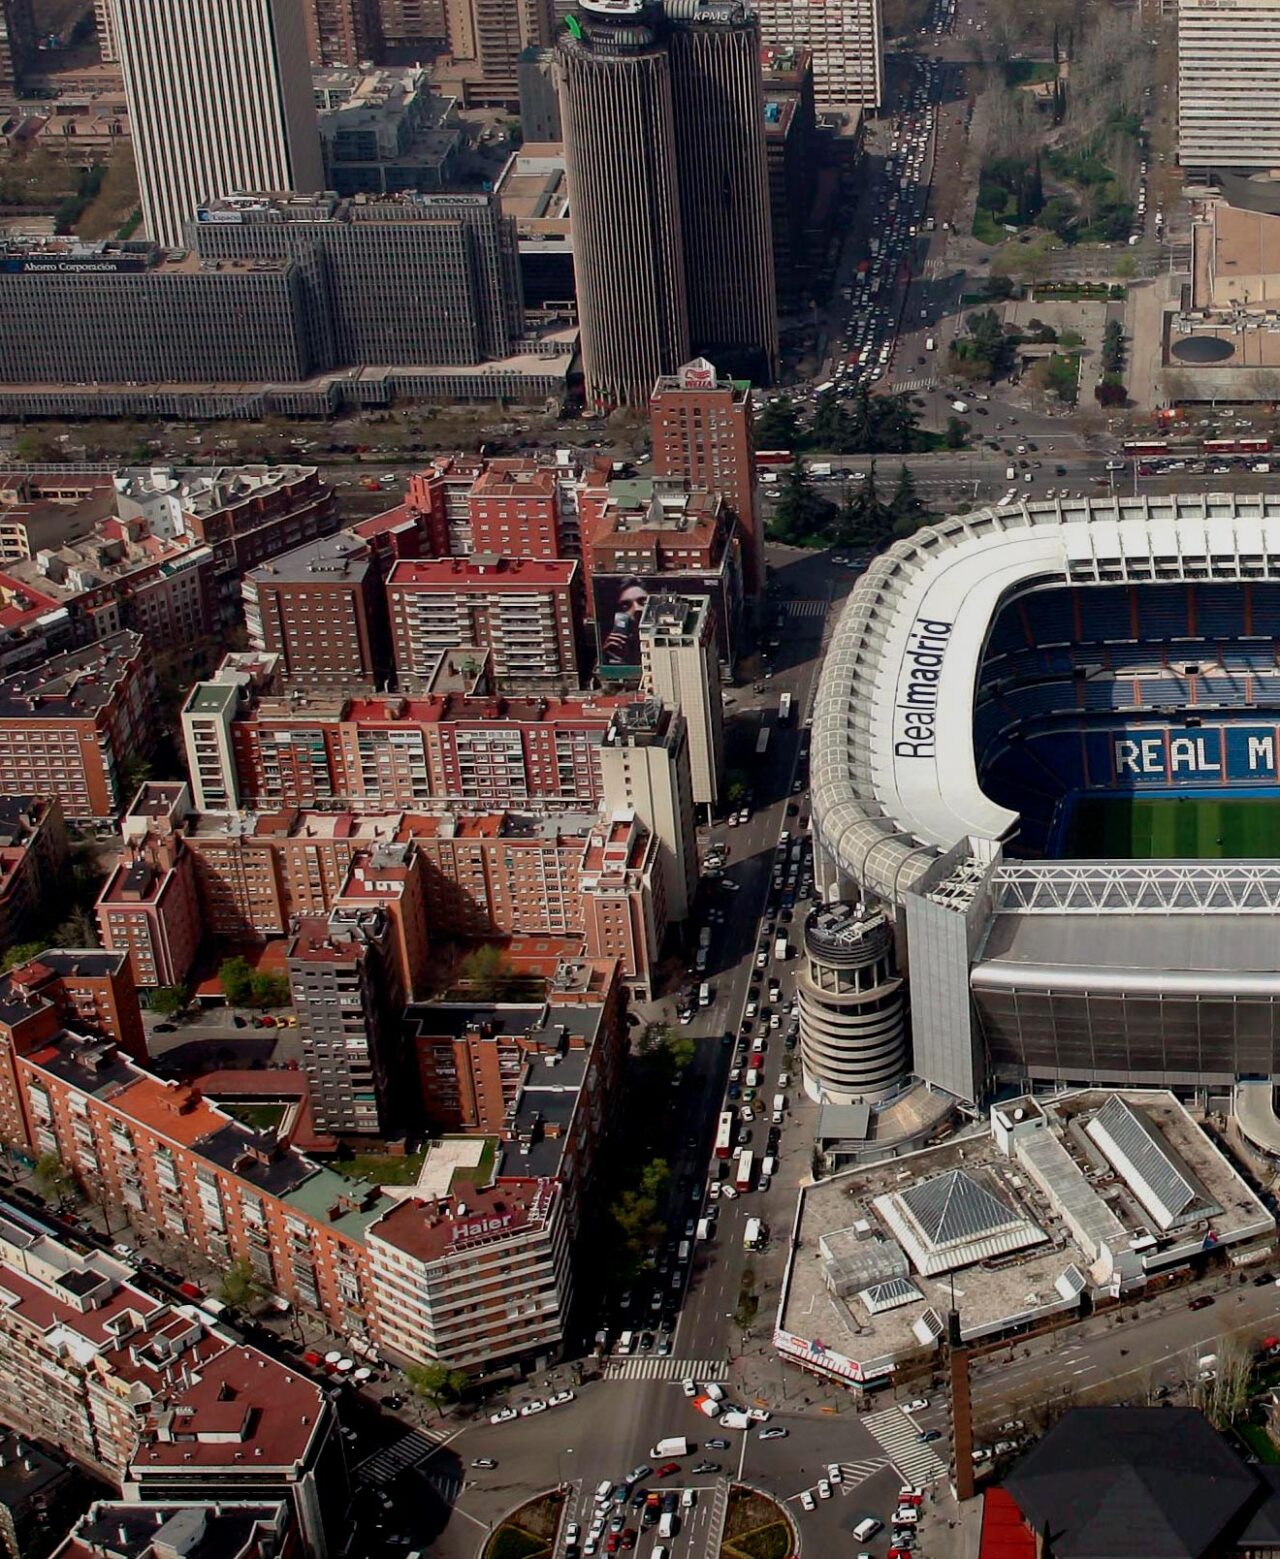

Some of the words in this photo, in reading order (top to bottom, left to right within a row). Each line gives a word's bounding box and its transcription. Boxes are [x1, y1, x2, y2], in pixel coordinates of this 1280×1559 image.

[693, 12, 728, 21] KPMG
[24, 263, 57, 271] Ahorro
[60, 262, 117, 272] Corporación
[894, 618, 953, 758] Realmadrid
[1115, 737, 1221, 773] REAL
[452, 1215, 512, 1239] Haier
